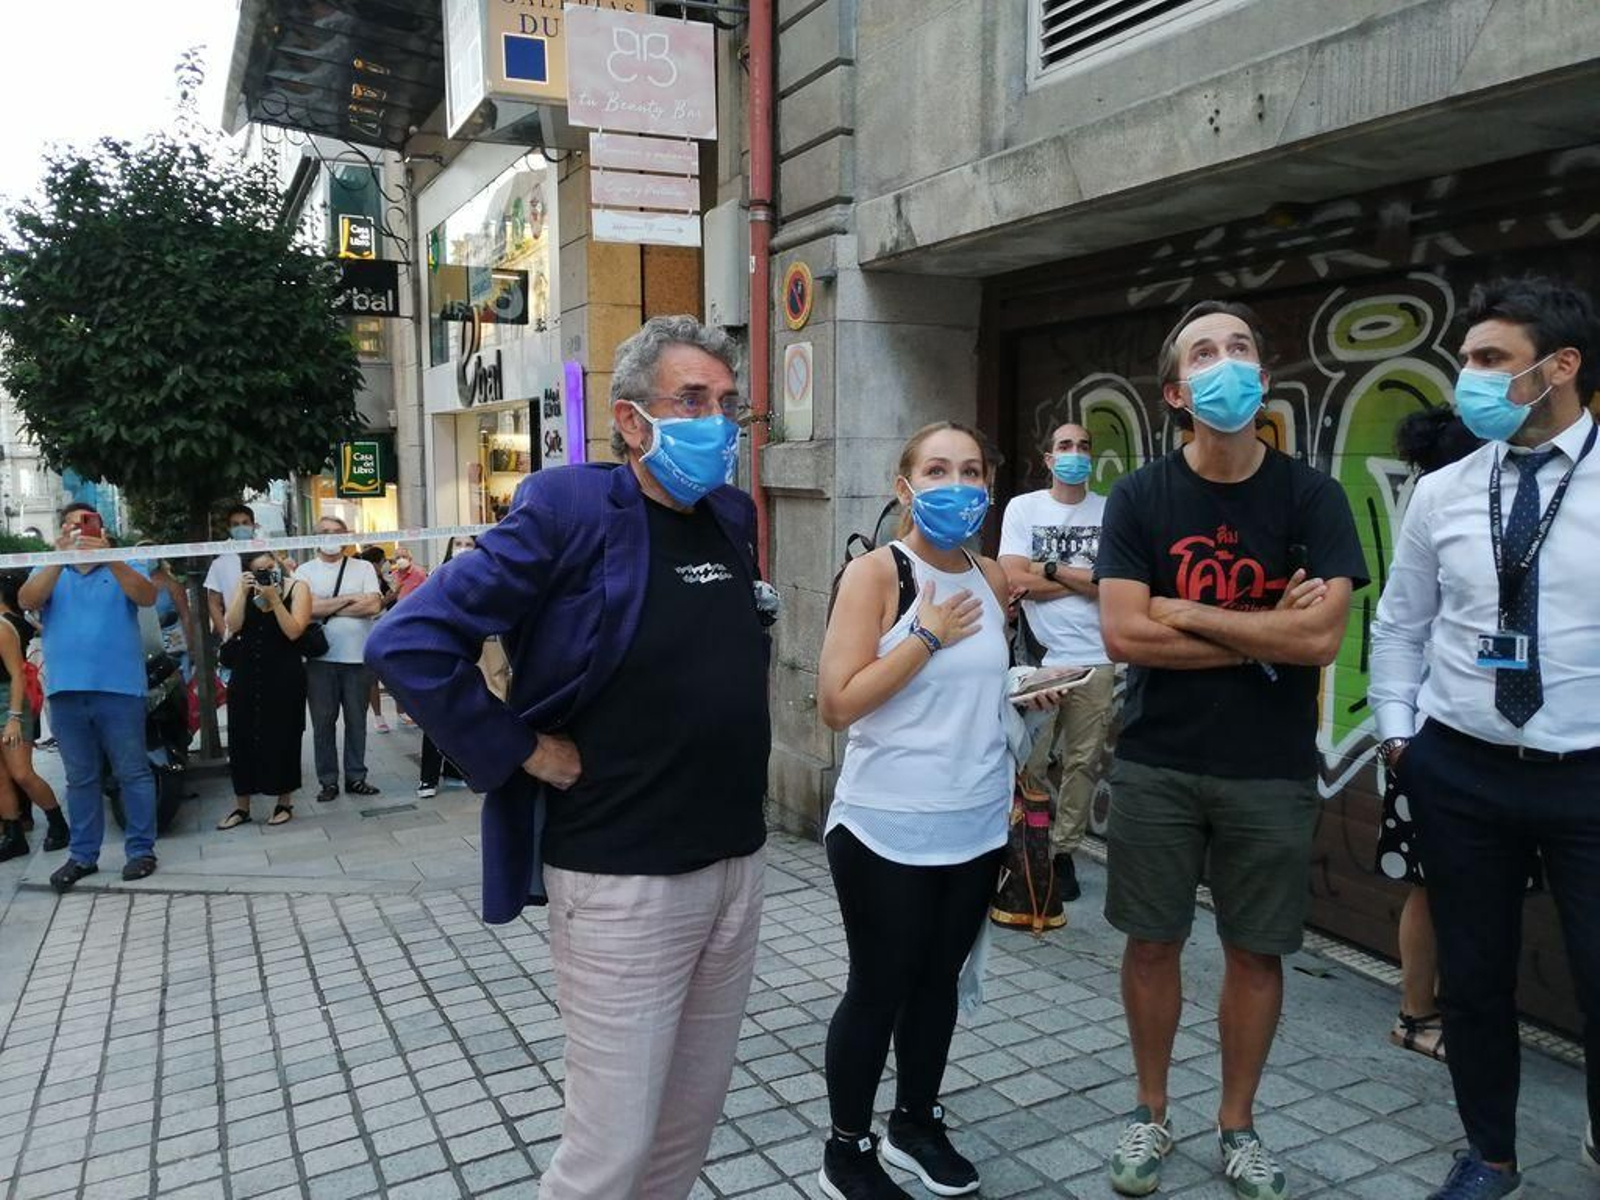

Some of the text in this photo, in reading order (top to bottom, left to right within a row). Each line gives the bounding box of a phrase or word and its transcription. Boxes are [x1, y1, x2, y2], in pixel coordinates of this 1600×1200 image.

[519, 13, 559, 38] DU
[352, 452, 374, 461] Casa
[352, 465, 375, 474] Libro
